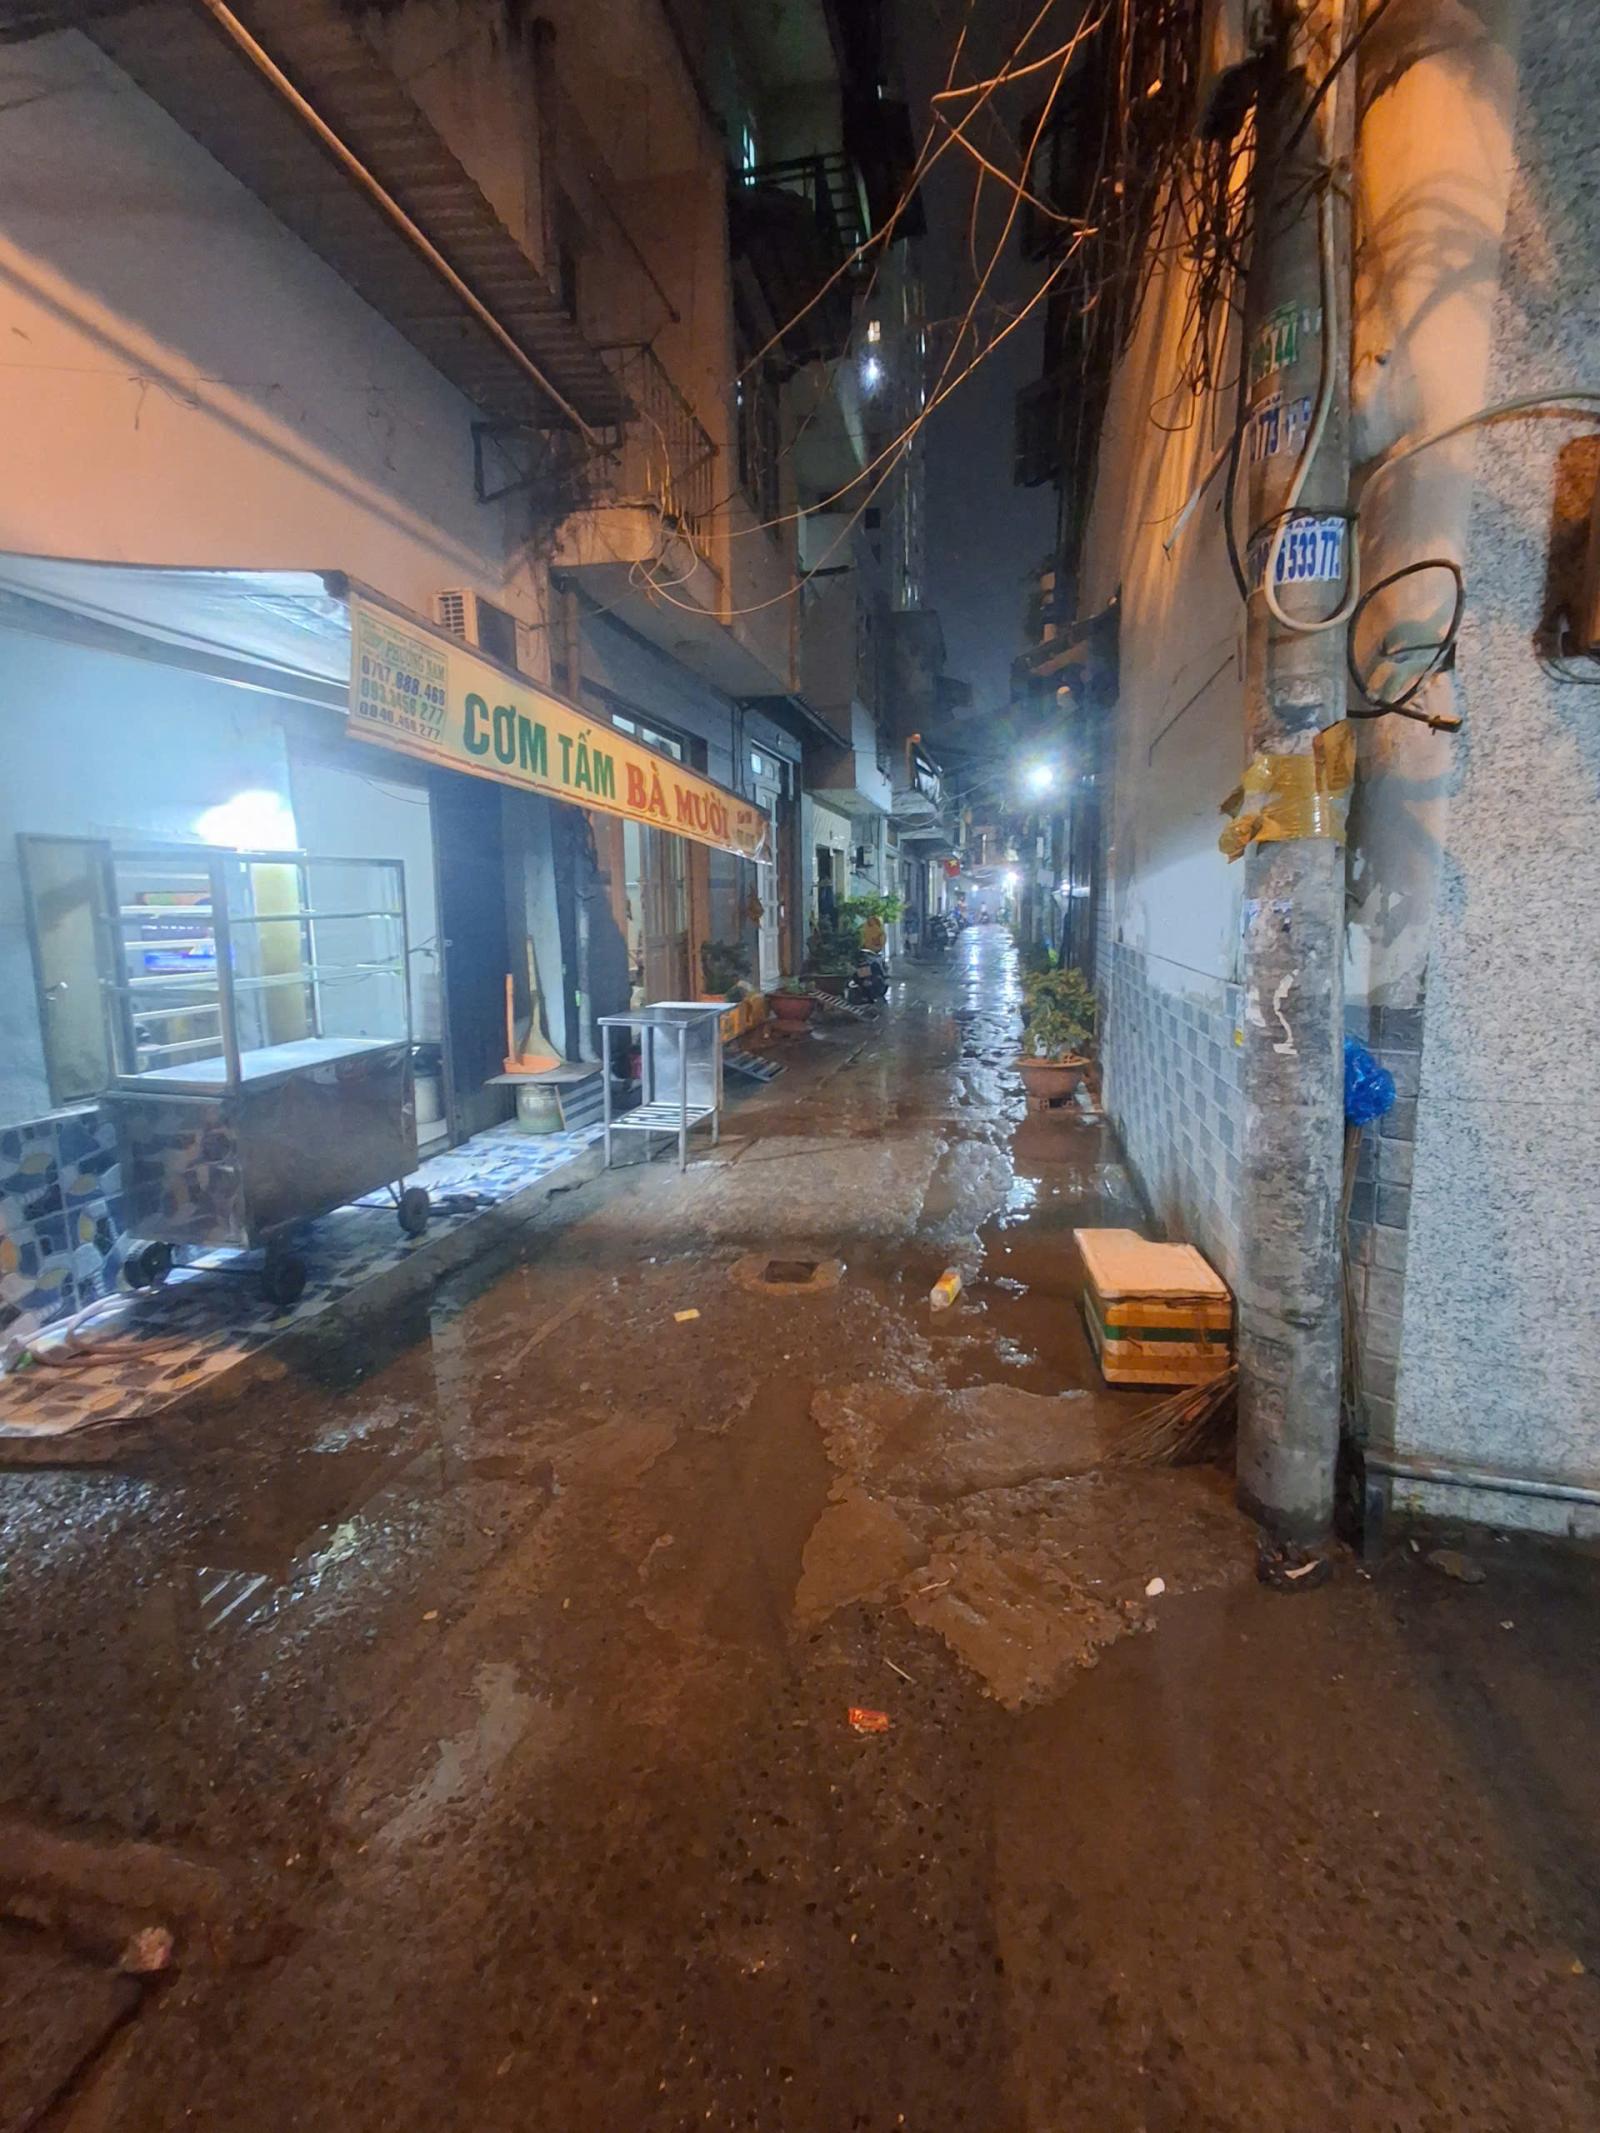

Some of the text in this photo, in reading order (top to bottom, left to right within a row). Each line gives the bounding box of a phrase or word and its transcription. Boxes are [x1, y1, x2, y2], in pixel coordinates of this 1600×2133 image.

[462, 691, 730, 840] CƠM TẤM BÀ MƯỜI
